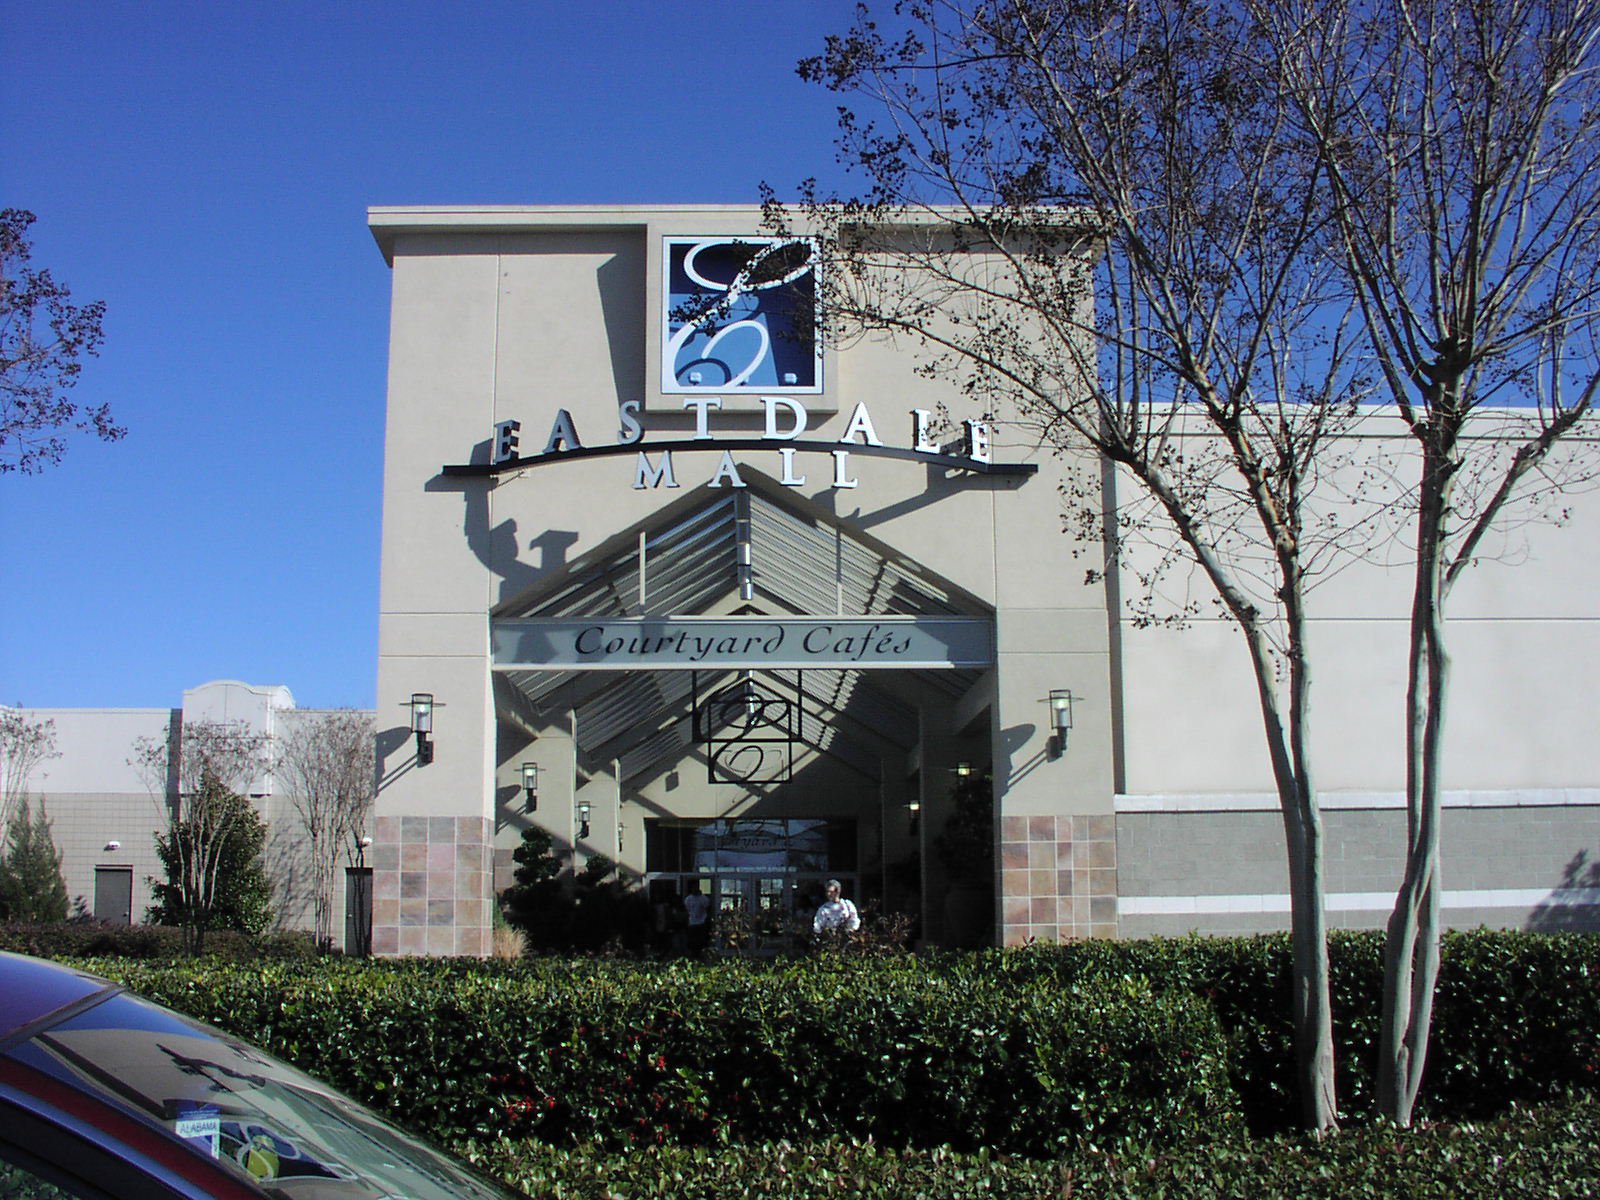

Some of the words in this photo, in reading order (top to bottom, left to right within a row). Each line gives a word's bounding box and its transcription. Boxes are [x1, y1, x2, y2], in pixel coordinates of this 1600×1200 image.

[493, 397, 990, 465] EASTDALE
[631, 448, 858, 489] MALL
[574, 625, 785, 661] Courtyard
[803, 624, 912, 661] Cafés
[179, 1121, 218, 1134] ALABAMA
